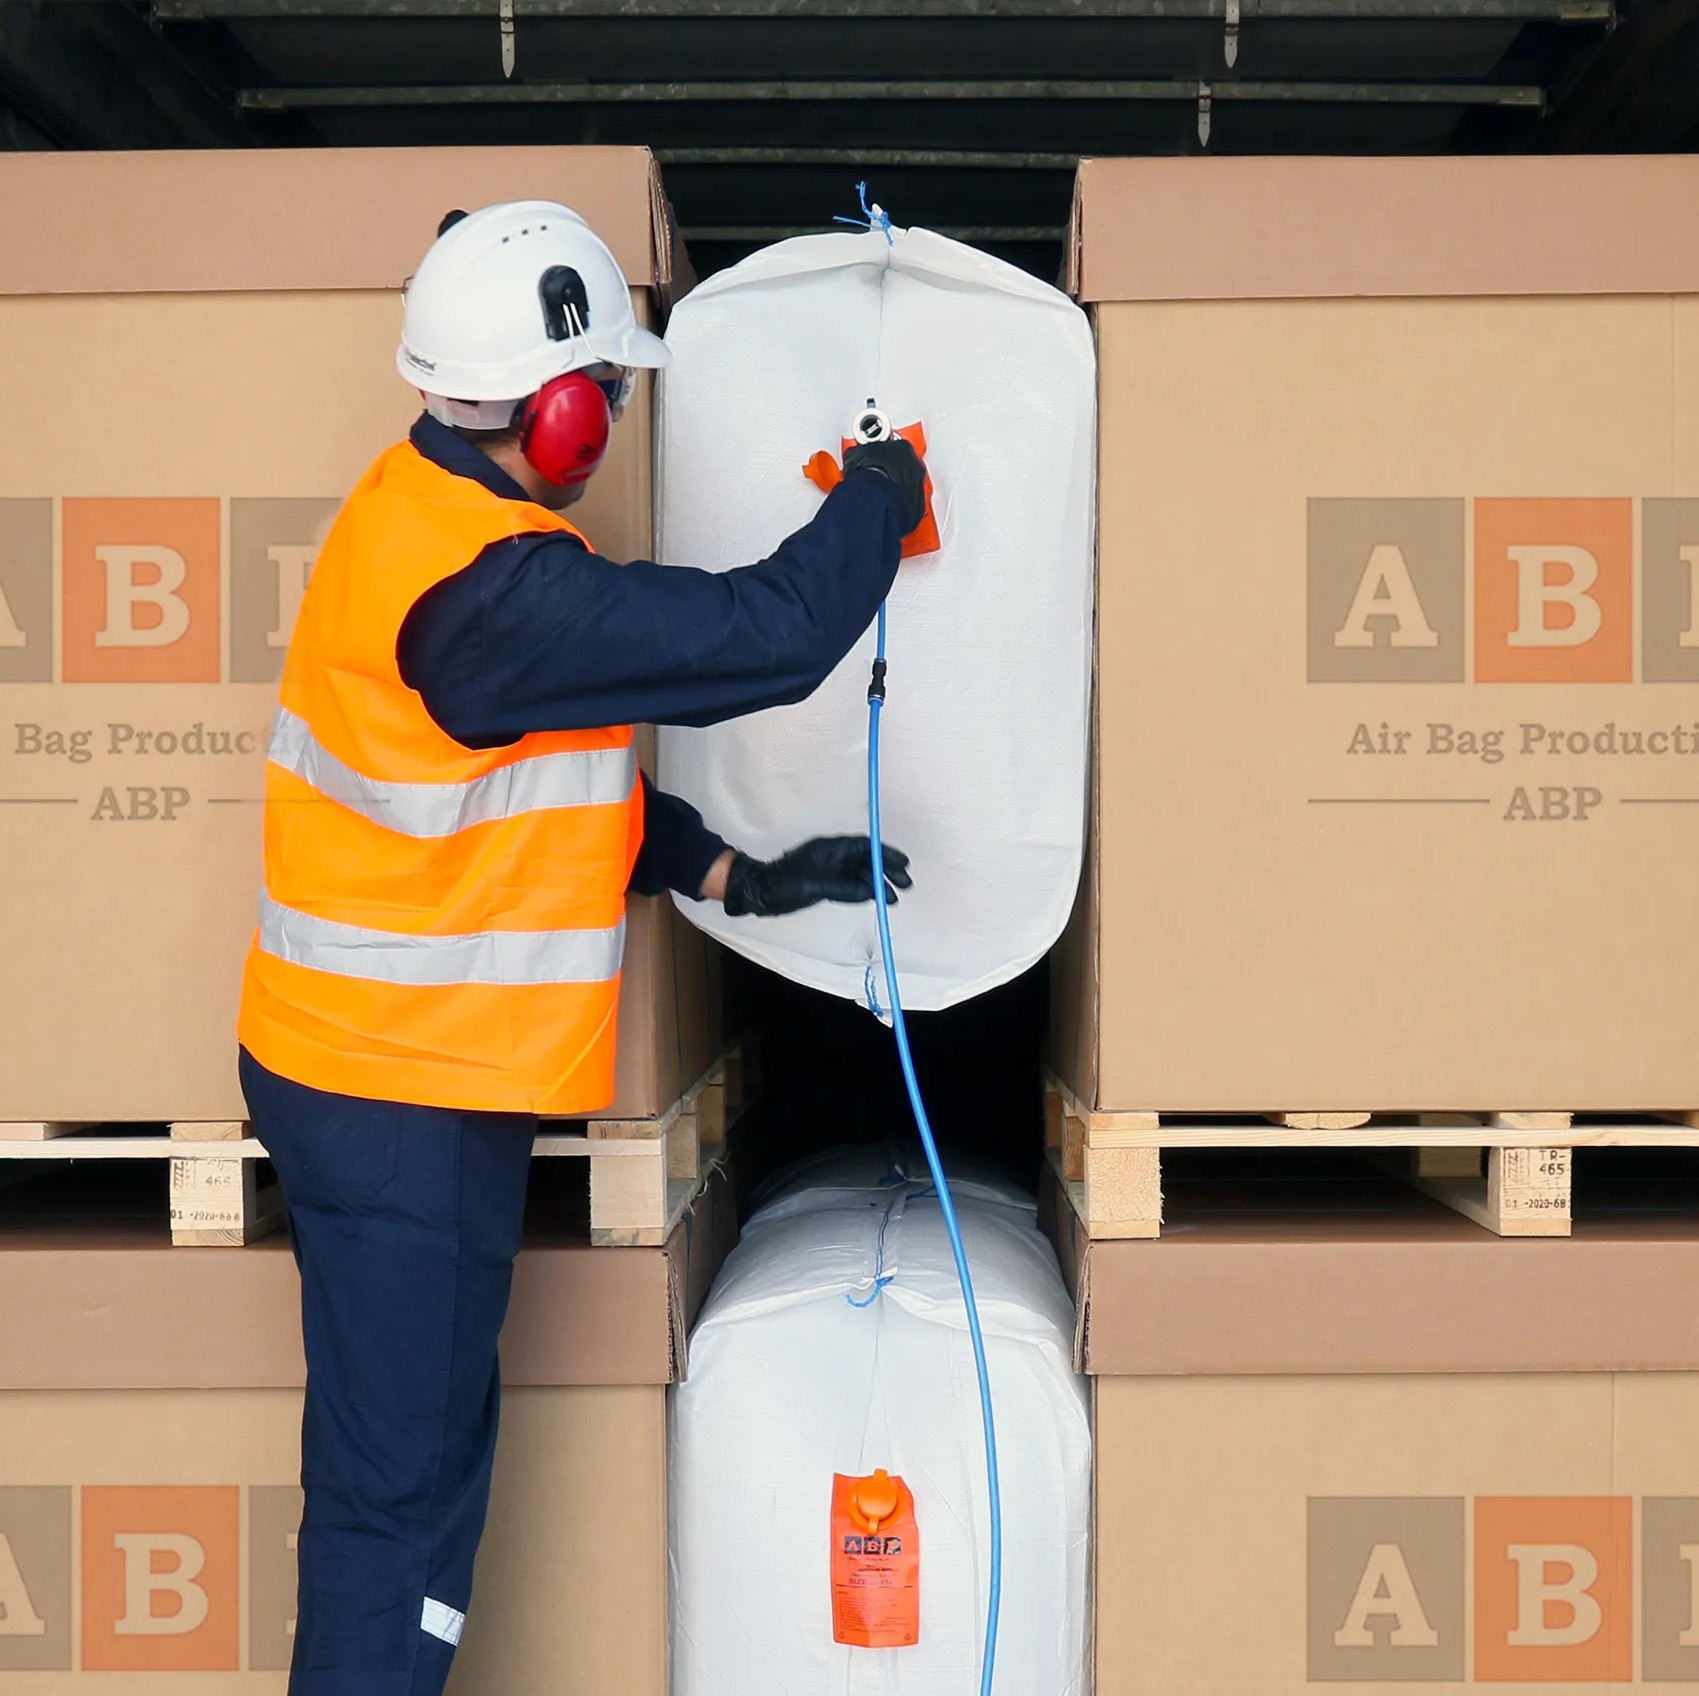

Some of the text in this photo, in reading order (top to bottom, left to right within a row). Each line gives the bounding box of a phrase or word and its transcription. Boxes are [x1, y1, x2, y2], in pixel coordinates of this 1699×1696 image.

[13, 723, 94, 764] Bag
[1346, 721, 1412, 755] Air
[1426, 722, 1505, 764] Bag
[90, 786, 191, 821] ABP
[1502, 786, 1603, 821] ABP
[1538, 1162, 1566, 1176] 465
